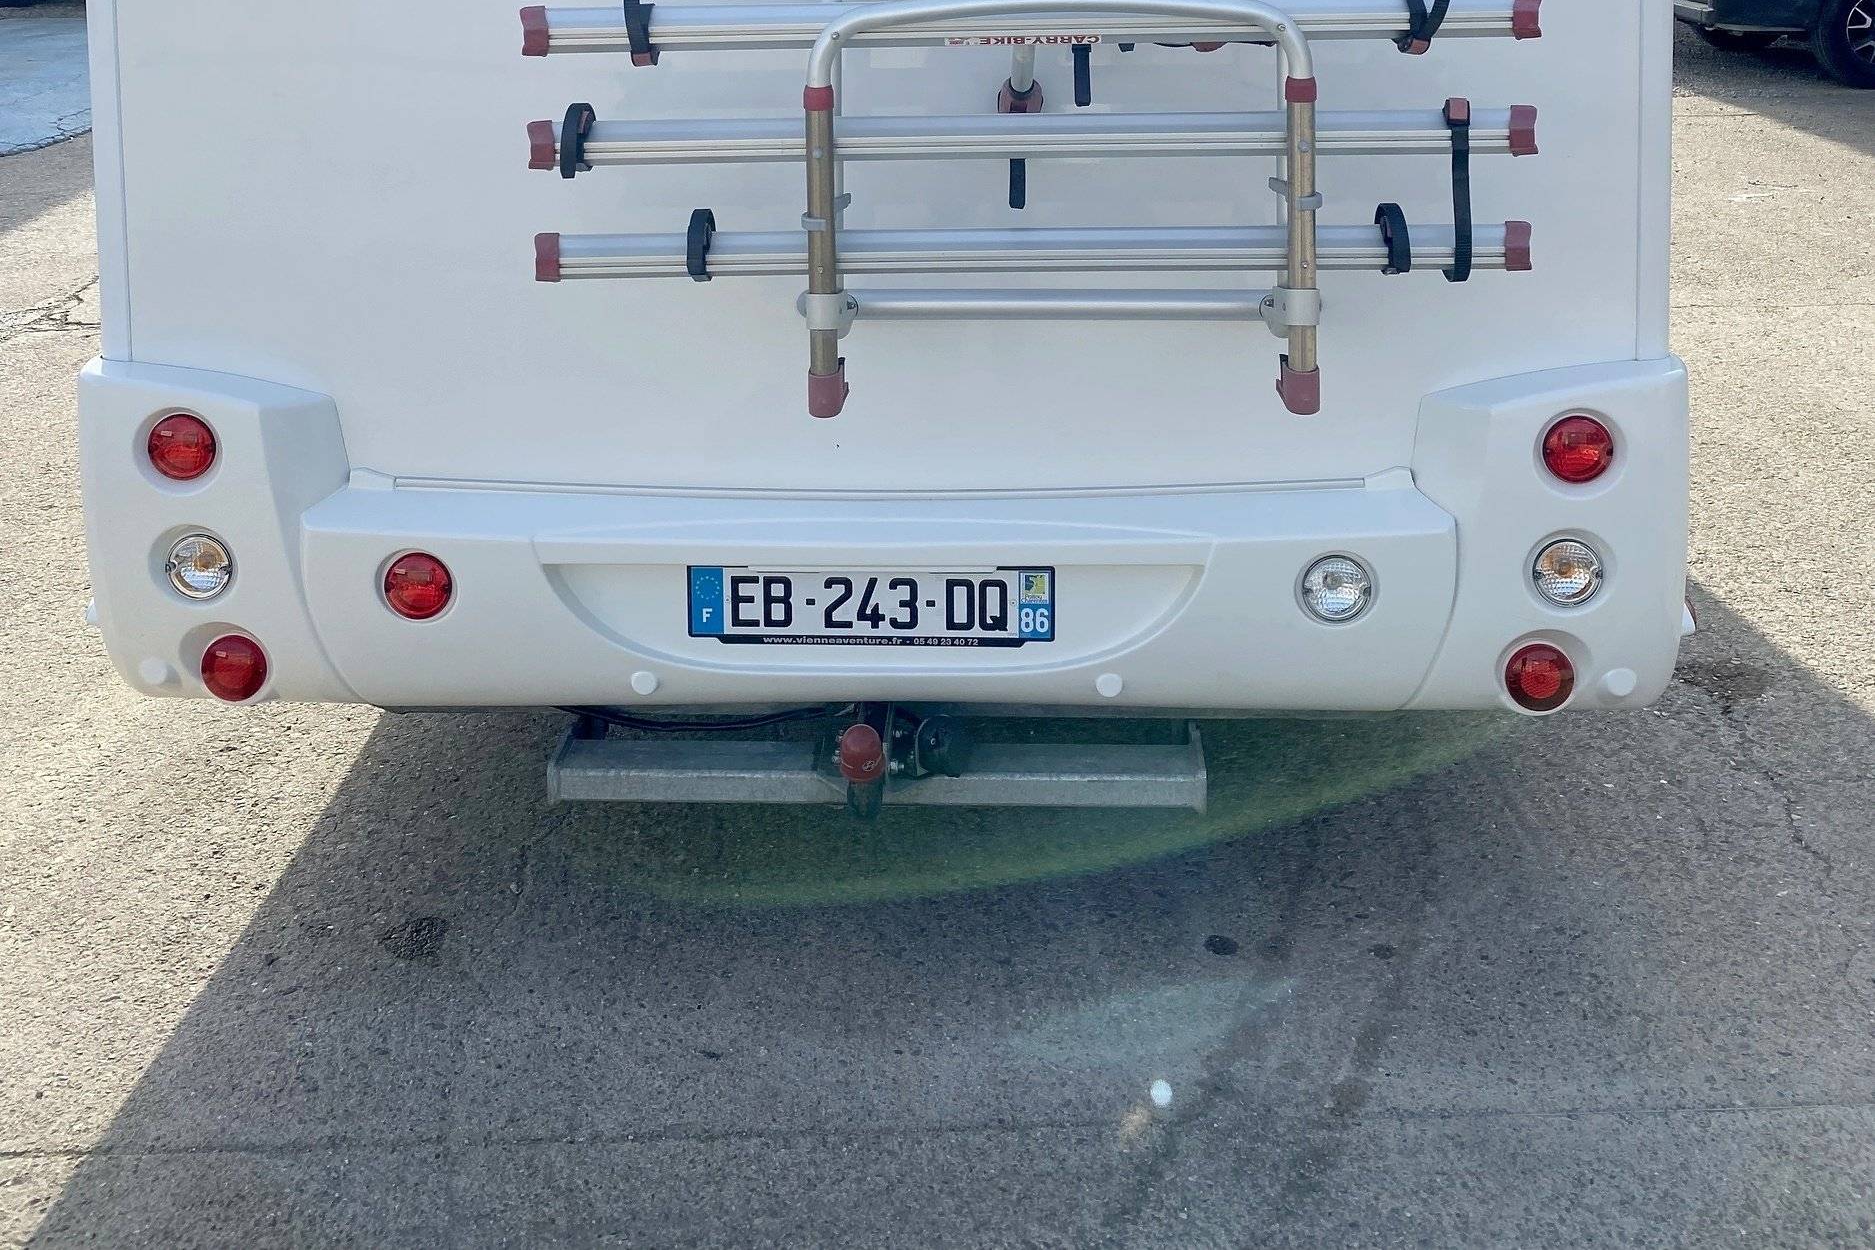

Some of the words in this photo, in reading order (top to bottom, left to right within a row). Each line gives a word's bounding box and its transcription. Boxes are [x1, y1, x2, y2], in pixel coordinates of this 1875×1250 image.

[979, 35, 1101, 45] CARRY-BIKE
[730, 575, 1009, 632] EB-243-DQ
[702, 607, 713, 623] F
[1020, 607, 1049, 633] 86
[762, 635, 903, 645] www.vienneaventure.fr
[913, 637, 925, 645] 05
[926, 637, 939, 645] 49
[940, 638, 952, 646] 23
[953, 638, 966, 646] 40
[967, 638, 979, 646] 72
